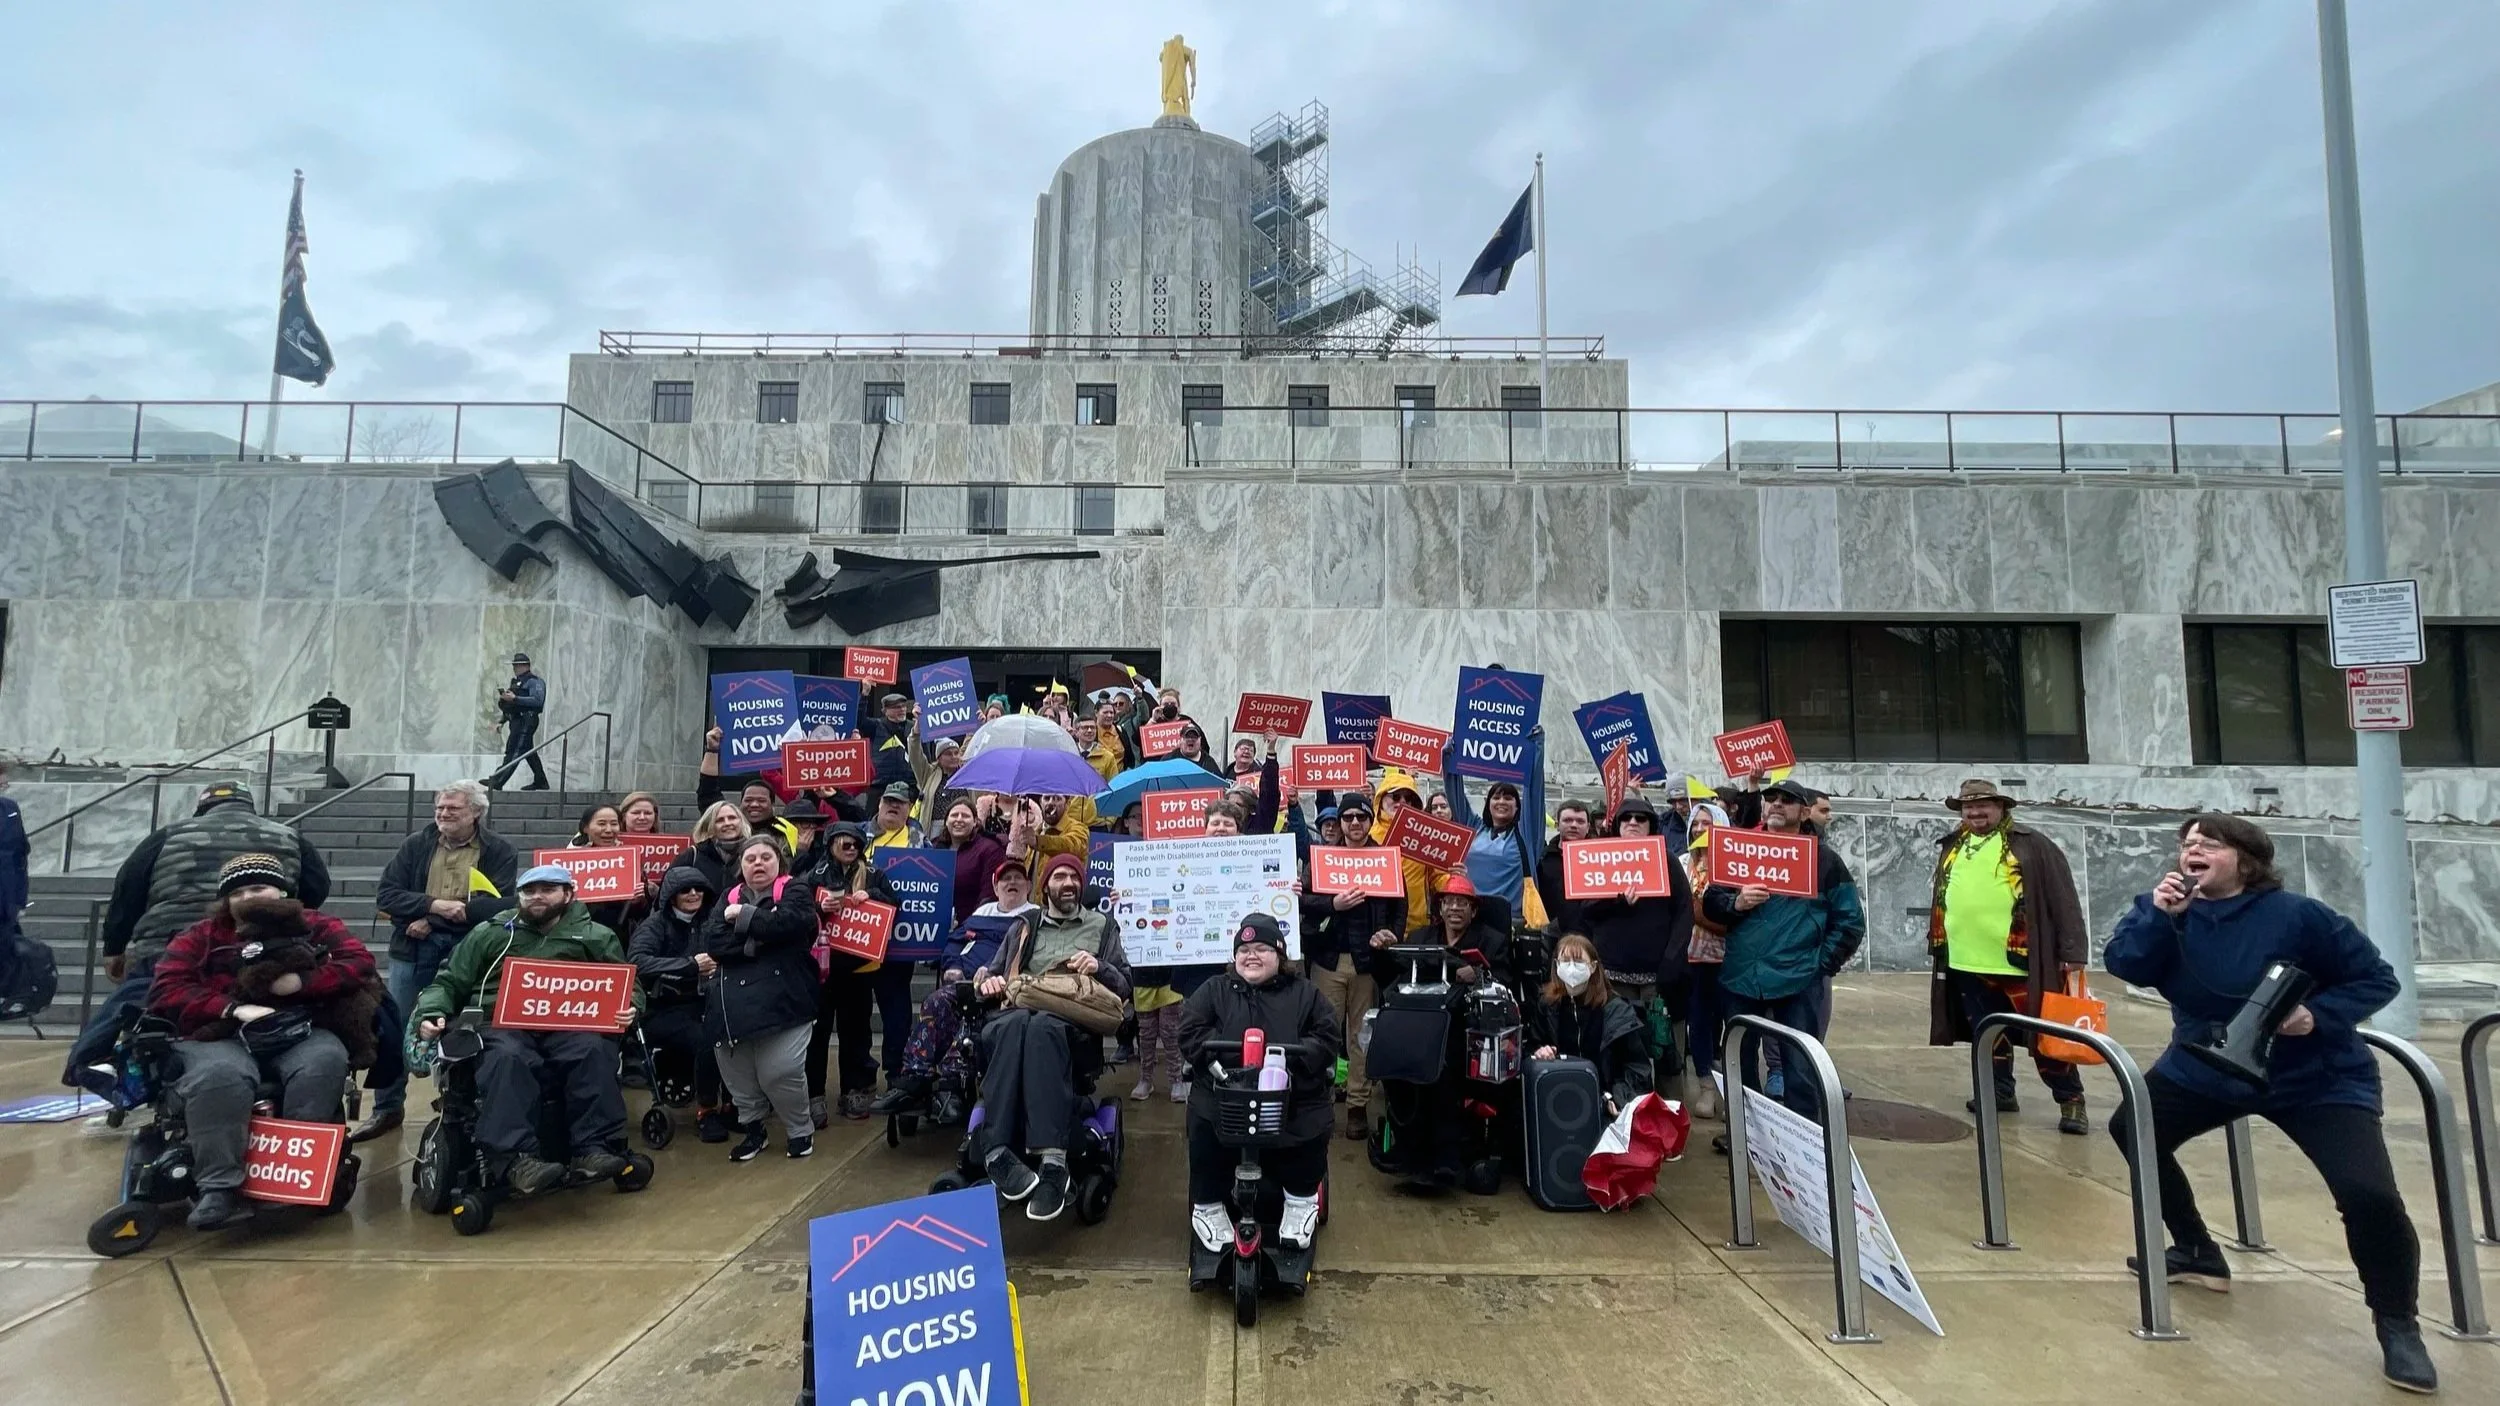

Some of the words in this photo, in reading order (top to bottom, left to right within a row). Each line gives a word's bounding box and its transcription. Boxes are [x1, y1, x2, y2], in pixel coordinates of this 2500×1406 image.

[853, 653, 890, 665] Support
[853, 665, 865, 674] SB
[867, 667, 885, 677] 444
[2349, 671, 2365, 683] NO
[2366, 672, 2405, 680] PARKING
[923, 680, 964, 695] HOUSING
[2355, 688, 2403, 696] RESERVED
[728, 698, 784, 712] HOUSING
[802, 700, 847, 711] HOUSING
[927, 692, 965, 708] ACCESS
[1249, 700, 1299, 715] Support
[1468, 699, 1526, 717] HOUSING
[2368, 707, 2392, 715] ONLY
[732, 714, 785, 730] ACCESS
[803, 714, 844, 726] ACCESS
[927, 706, 971, 728] NOW
[1247, 716, 1263, 727] SB
[1266, 717, 1289, 729] 444
[1468, 718, 1521, 736] ACCESS
[1591, 719, 1633, 740] HOUSING
[1152, 740, 1165, 750] SB
[1387, 727, 1440, 749] Support
[1726, 733, 1774, 752] Support
[796, 748, 857, 763] Support
[1303, 752, 1355, 765] Support
[1387, 744, 1403, 758] SB
[1406, 749, 1430, 765] 444
[1462, 738, 1523, 765] NOW
[1735, 755, 1752, 768] SB
[1754, 750, 1775, 764] 444
[800, 769, 819, 780] SB
[823, 766, 851, 779] 444
[1306, 770, 1323, 781] SB
[1325, 769, 1350, 780] 444
[1160, 801, 1186, 813] 444
[1191, 798, 1209, 809] SB
[1155, 815, 1205, 832] upport
[1405, 817, 1462, 847] Support
[1172, 841, 1200, 850] Support
[1201, 839, 1237, 847] Accessible
[1400, 836, 1418, 851] SB
[1421, 844, 1448, 862] 444
[1723, 837, 1799, 861] Support
[1125, 854, 1149, 863] People
[1150, 853, 1166, 861] with
[1167, 852, 1204, 860] Disabilities
[1241, 848, 1282, 857] Oregonians
[1324, 854, 1388, 869] Support
[1578, 848, 1650, 867] Support
[1128, 867, 1151, 878] DRO
[1329, 872, 1349, 884] SB
[1353, 873, 1382, 887] 444
[1583, 872, 1606, 887] SB
[1611, 870, 1644, 886] 444
[1727, 861, 1749, 877] SB
[1754, 866, 1791, 884] 444
[583, 876, 618, 891] 444
[889, 880, 939, 893] OUSING
[1265, 880, 1289, 888] AARP
[901, 899, 936, 913] CESS
[840, 907, 882, 927] pport
[825, 921, 841, 937] SB
[844, 928, 871, 947] 444
[893, 921, 939, 942] OW
[521, 971, 614, 995] Support
[521, 999, 550, 1016] SB
[557, 1000, 599, 1018] 444
[286, 1137, 316, 1158] SB
[848, 1264, 976, 1317] HOUSING
[855, 1309, 978, 1369] ACCESS
